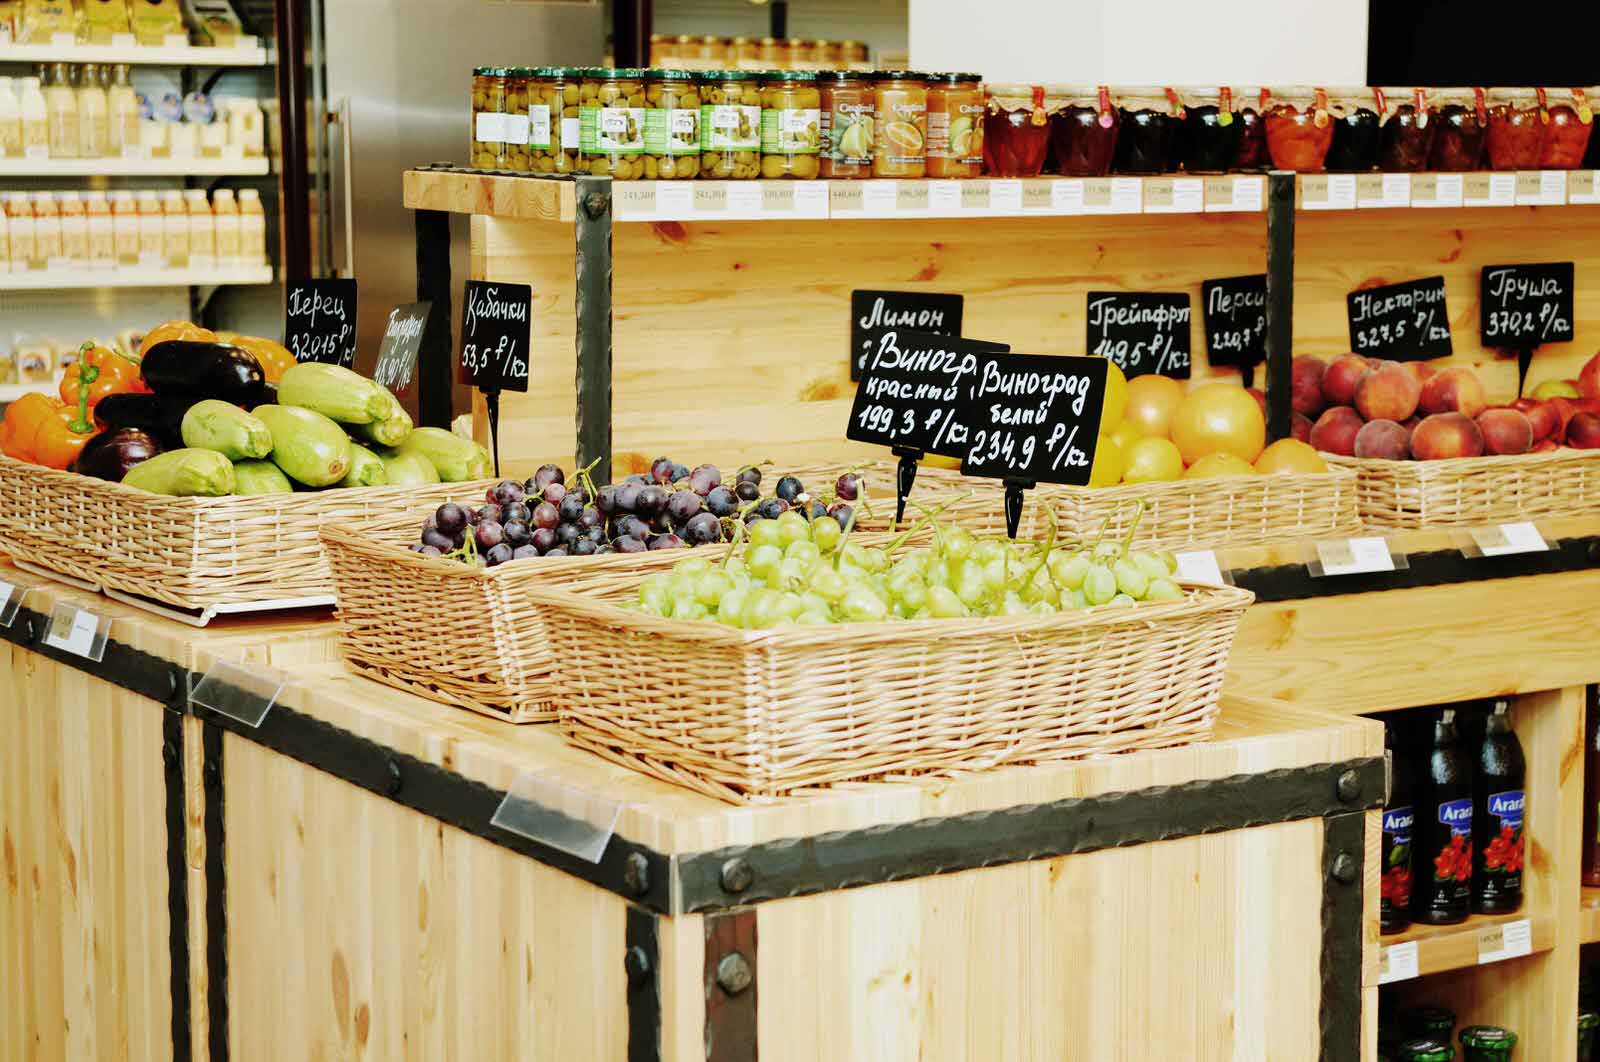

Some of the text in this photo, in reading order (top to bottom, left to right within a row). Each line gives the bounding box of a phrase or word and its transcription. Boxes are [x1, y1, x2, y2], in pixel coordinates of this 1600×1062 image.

[1209, 286, 1264, 322] Перси
[1353, 286, 1445, 321] Нектарин
[1488, 269, 1562, 307] Груша
[287, 288, 345, 328] Перец
[465, 287, 526, 336] Кабачки
[859, 297, 944, 330] Лимон
[1088, 296, 1191, 337] Грейпфрут
[1486, 312, 1535, 336] 370,2
[1357, 319, 1406, 348] 327,5
[461, 335, 528, 378] 53,5 ₽/кг
[871, 331, 977, 387] Виногр
[1093, 333, 1190, 374] 149,5 ₽/кг
[865, 377, 959, 401] красный
[978, 360, 1091, 416] Виноград
[858, 404, 915, 439] 199,3
[989, 402, 1049, 425] белый
[967, 422, 1090, 471] 234,9 ₽/кг
